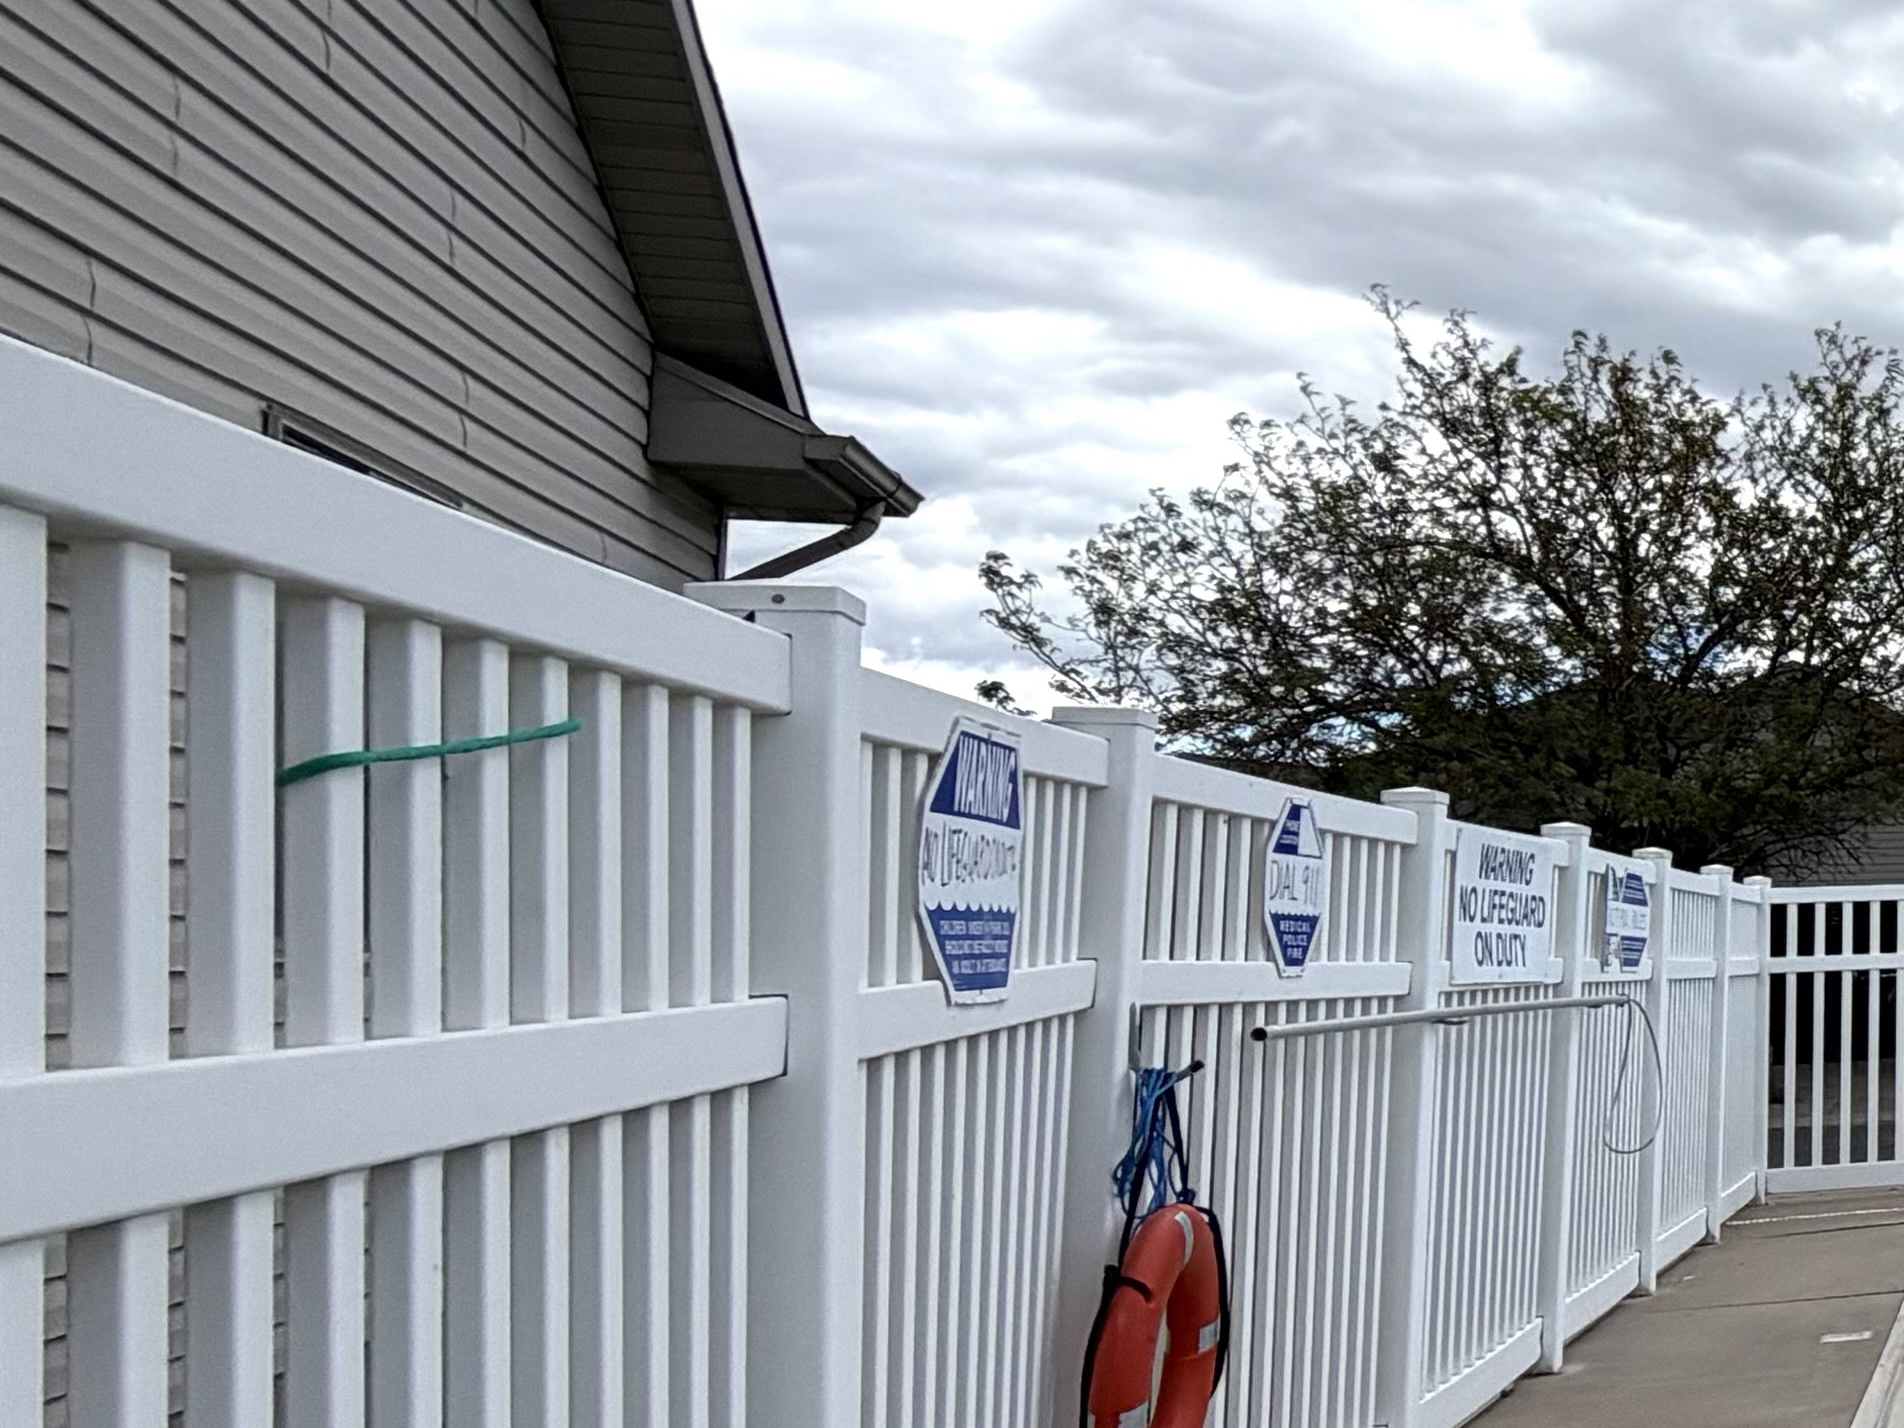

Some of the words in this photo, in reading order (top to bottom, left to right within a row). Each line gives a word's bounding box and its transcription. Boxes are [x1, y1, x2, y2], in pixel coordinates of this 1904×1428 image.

[953, 735, 1016, 824] WARNING
[1269, 859, 1299, 901] DIAL
[1302, 864, 1321, 908] 911
[1478, 843, 1536, 886] WARNING
[1279, 919, 1313, 933] MEDICAL
[1458, 884, 1478, 923] NO
[1480, 887, 1546, 928] LIFEGUARD
[1282, 933, 1308, 946] POLICE
[1474, 930, 1494, 967] ON
[1495, 932, 1527, 968] DUTY
